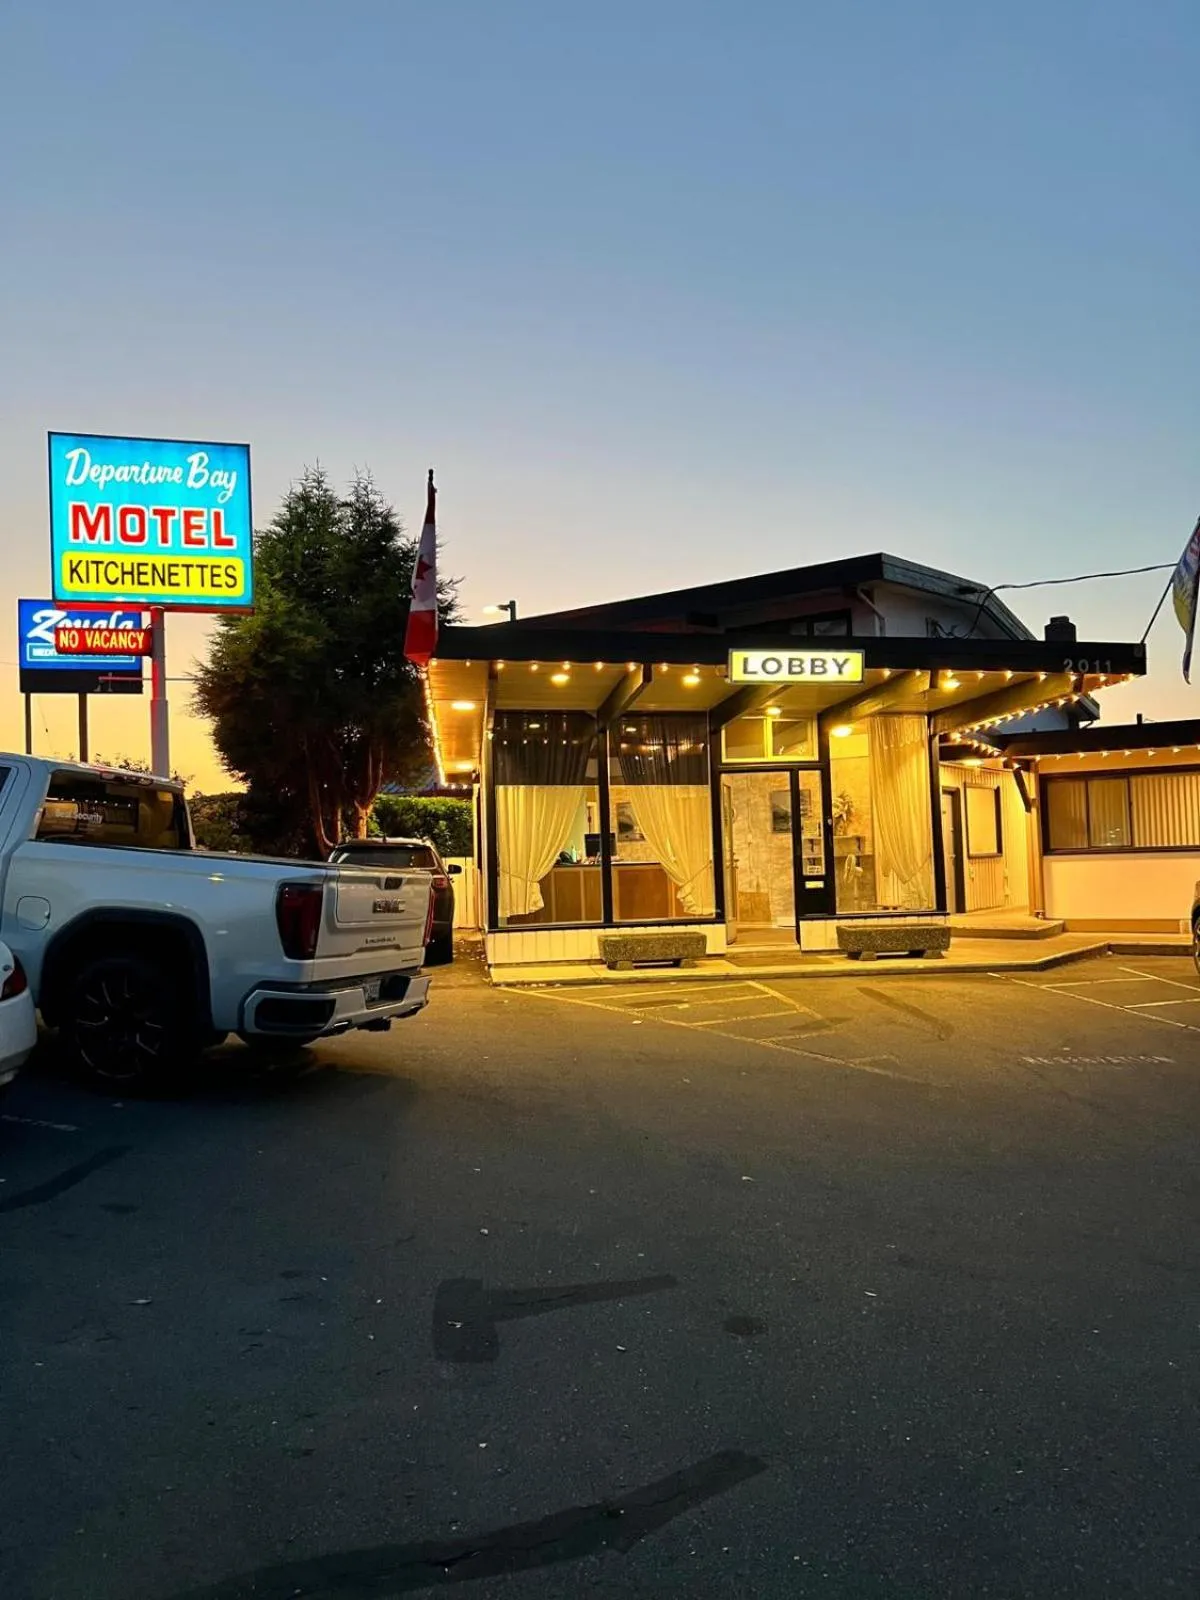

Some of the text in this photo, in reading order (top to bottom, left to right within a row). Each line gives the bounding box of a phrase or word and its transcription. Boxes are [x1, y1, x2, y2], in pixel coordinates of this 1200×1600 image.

[65, 447, 238, 504] Departure Bay
[70, 502, 236, 549] MOTEL
[69, 559, 238, 588] KITCHENETTES
[59, 630, 145, 649] NO VACANCY
[742, 656, 850, 676] LOBBY
[1063, 658, 1112, 673] 2011
